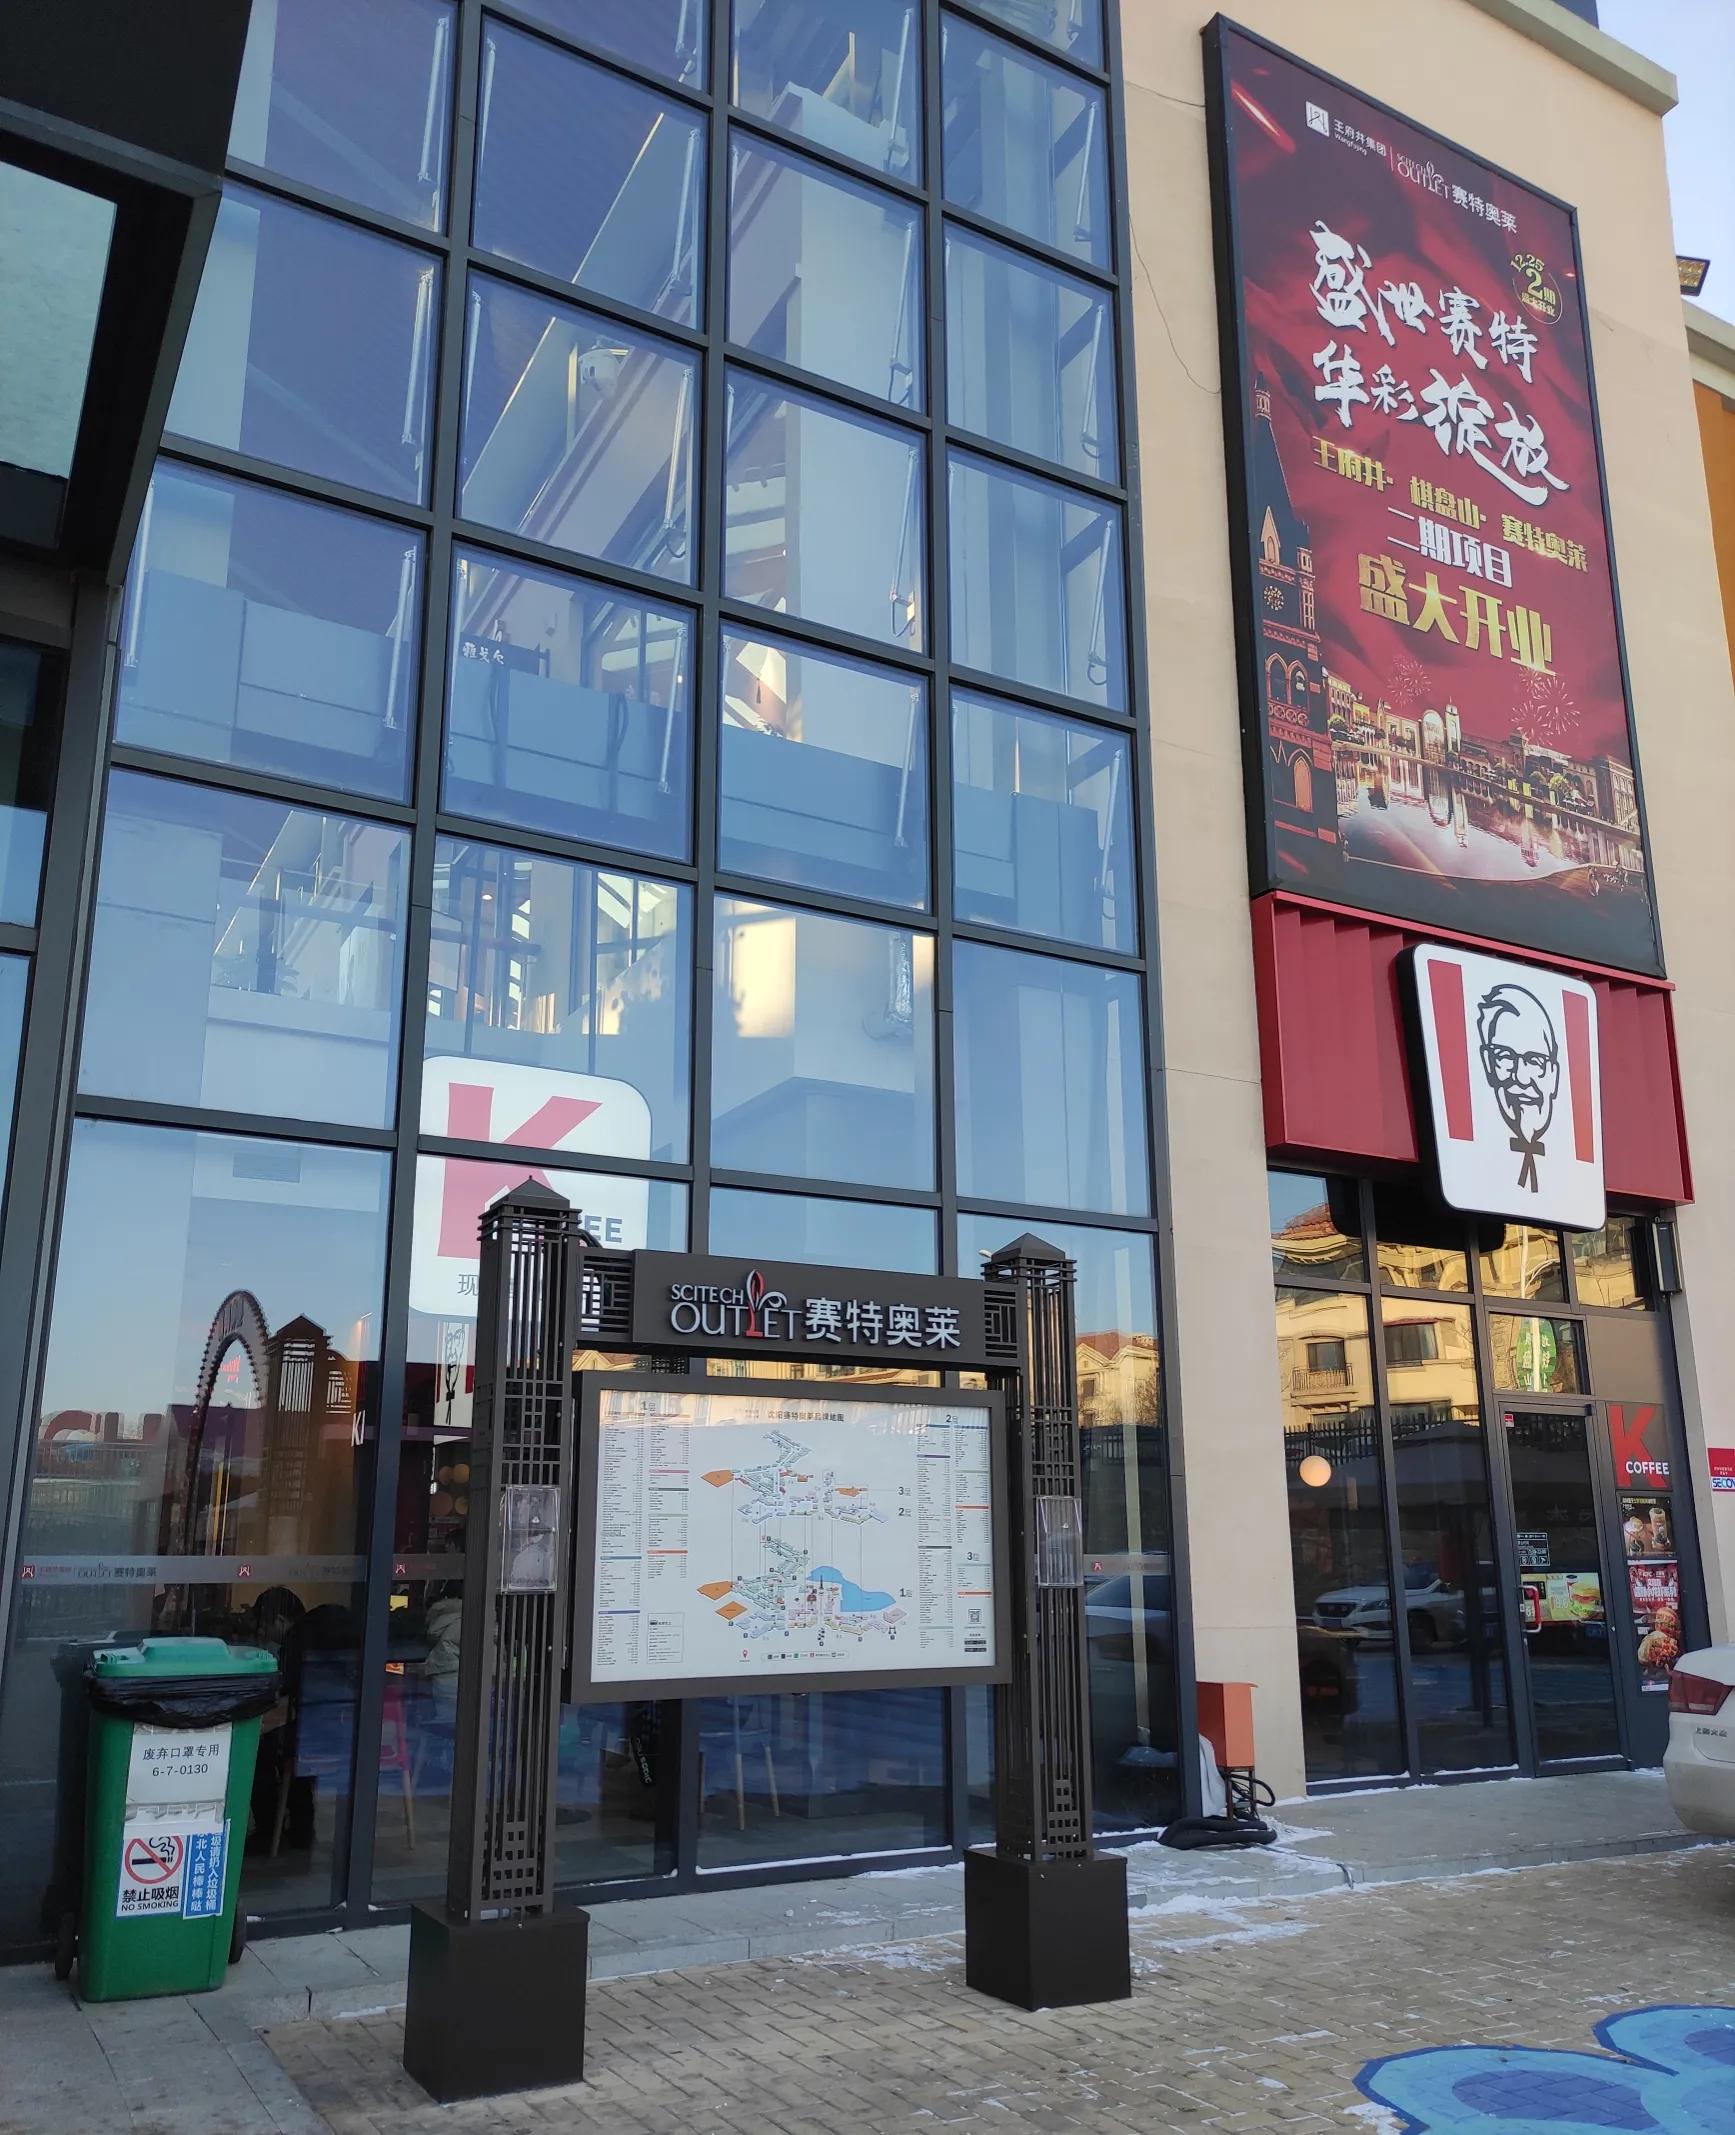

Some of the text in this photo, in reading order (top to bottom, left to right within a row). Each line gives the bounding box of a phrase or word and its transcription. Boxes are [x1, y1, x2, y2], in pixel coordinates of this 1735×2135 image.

[1334, 119, 1386, 156] 王府井集团
[1452, 184, 1517, 233] 赛特奥莱
[1510, 254, 1545, 272] 12.25
[1309, 220, 1538, 383] 盛世赛特
[1313, 340, 1570, 506] 华彩绽放
[1387, 506, 1513, 588] 二期项目
[1501, 513, 1588, 573] 赛特奥莱
[1358, 553, 1556, 677] 盛大开业
[671, 1284, 744, 1305] SCITECH
[671, 1291, 961, 1349] OUTLET 赛特奥莱
[1606, 1404, 1669, 1488] K
[1625, 1461, 1670, 1476] COFFEE
[142, 1743, 220, 1761] 废弃口罩专用
[152, 1763, 208, 1777] 6-7-0130
[122, 1885, 180, 1903] 禁止吸烟
[190, 1833, 208, 1912] 北人民棒棒哒
[205, 1832, 222, 1911] 圾请扔入垃圾桶
[121, 1900, 179, 1911] NO SMOKING
